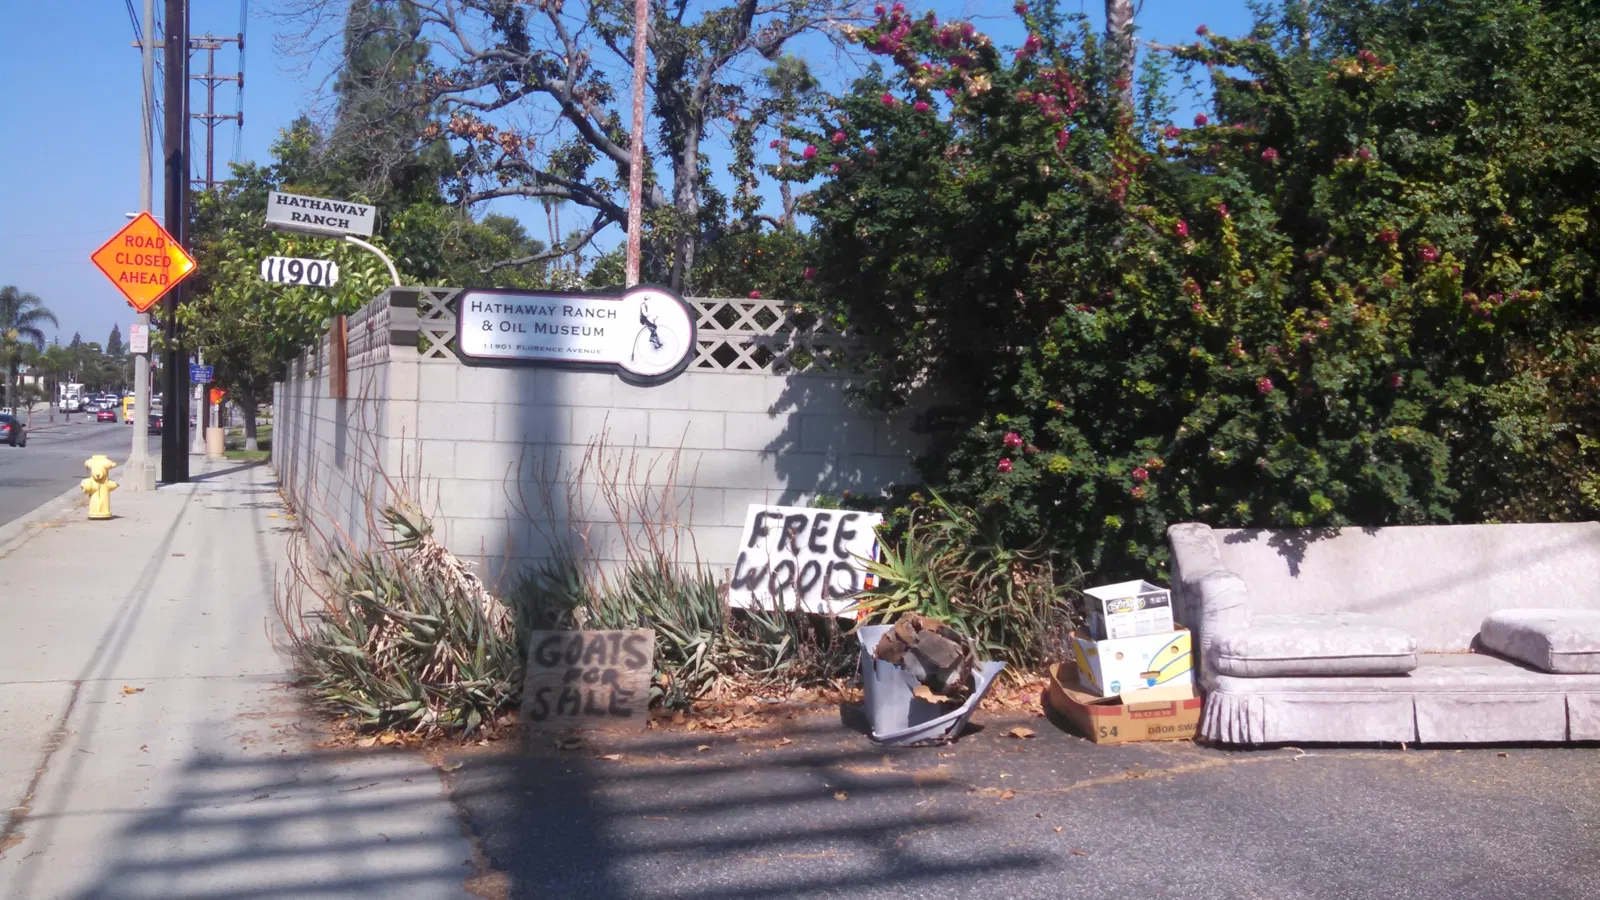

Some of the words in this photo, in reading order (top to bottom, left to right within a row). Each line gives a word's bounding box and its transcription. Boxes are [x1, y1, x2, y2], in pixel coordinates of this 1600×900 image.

[276, 195, 368, 217] HATHAWAY
[291, 211, 350, 229] RANCH
[125, 235, 165, 249] ROAD
[115, 252, 172, 268] CLOSED
[119, 271, 169, 286] AHEAD
[267, 258, 333, 287] 11901
[471, 300, 557, 316] HATHAWAY
[562, 305, 617, 319] RANCH
[481, 320, 493, 332] &
[499, 320, 527, 334] OIL
[534, 322, 605, 337] MUSEUM
[516, 344, 564, 353] FLORENCE
[748, 511, 860, 559] FREE
[730, 551, 859, 600] WOOD
[535, 633, 648, 669] GOATS
[563, 666, 622, 692] FOR
[530, 687, 636, 721] SALE
